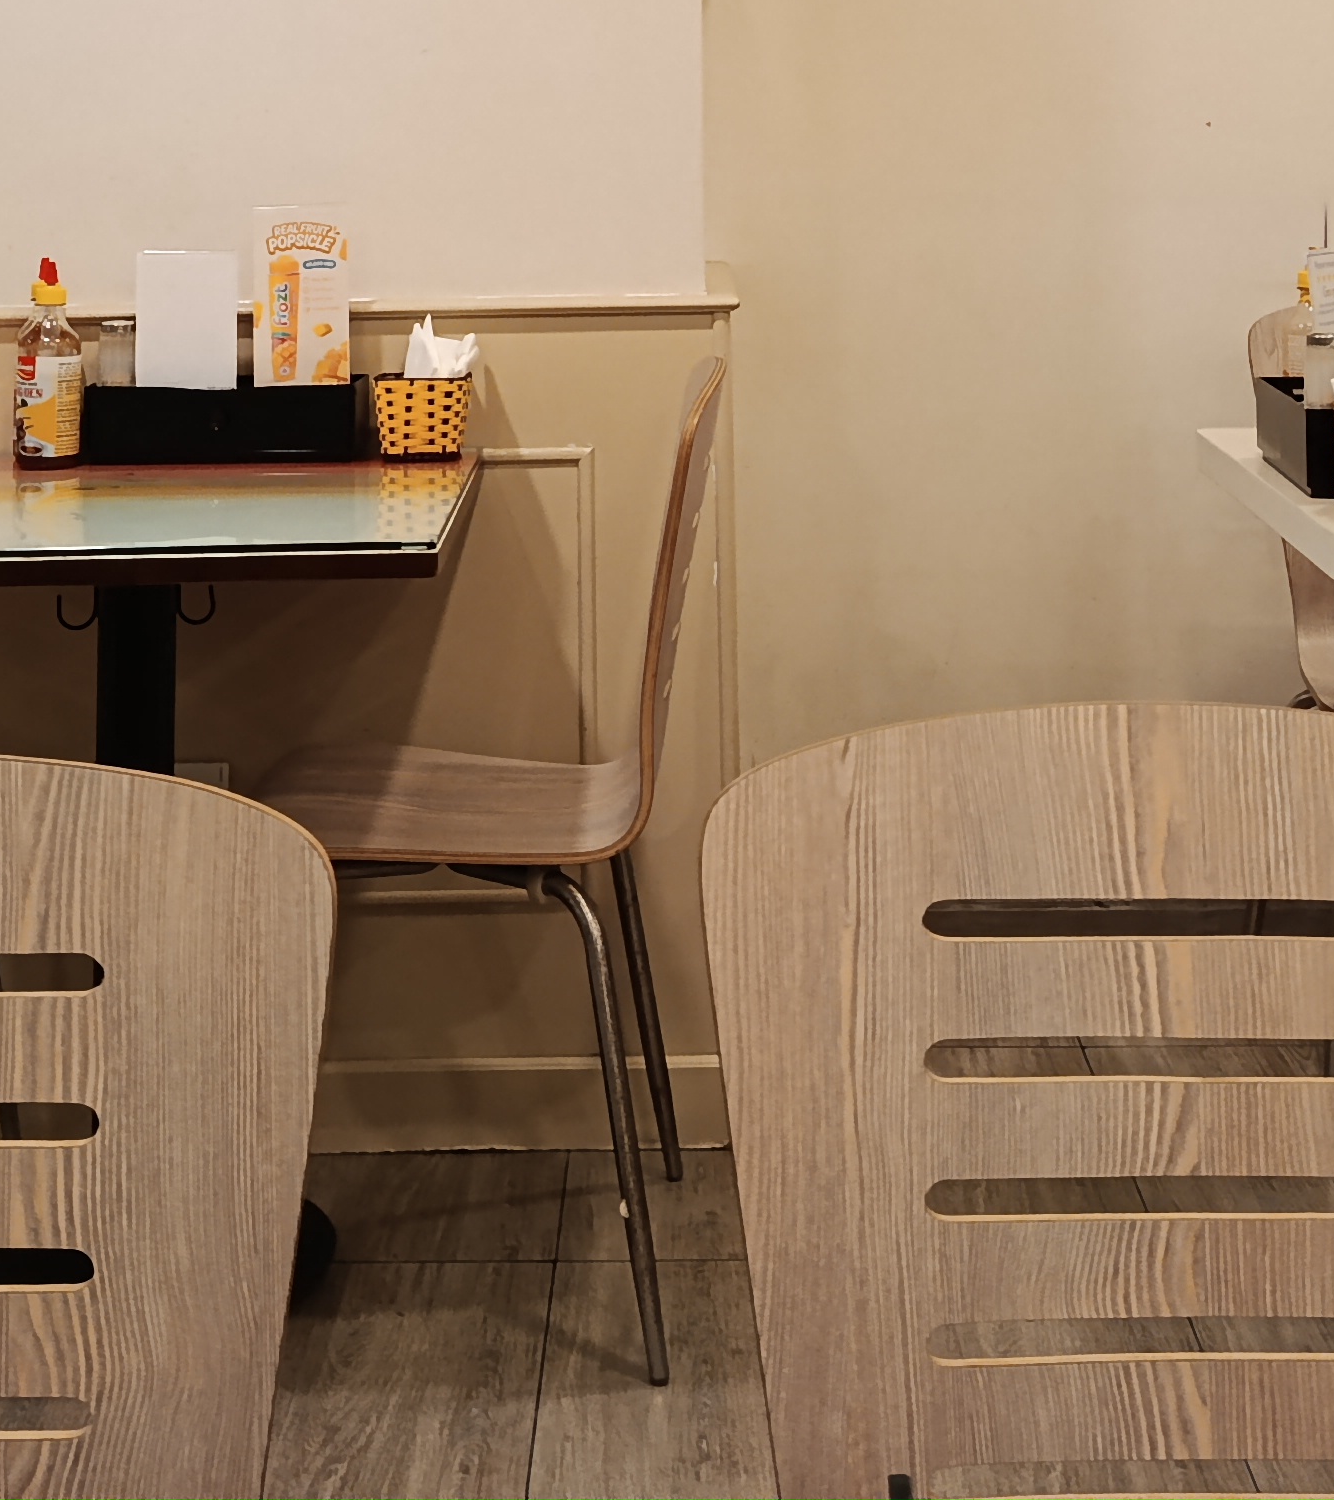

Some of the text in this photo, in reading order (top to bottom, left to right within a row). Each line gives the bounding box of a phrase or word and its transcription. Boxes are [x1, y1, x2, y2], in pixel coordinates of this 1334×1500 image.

[273, 223, 332, 236] REAL FRUIT
[268, 234, 334, 252] POPSICLE
[273, 284, 289, 326] frozt
